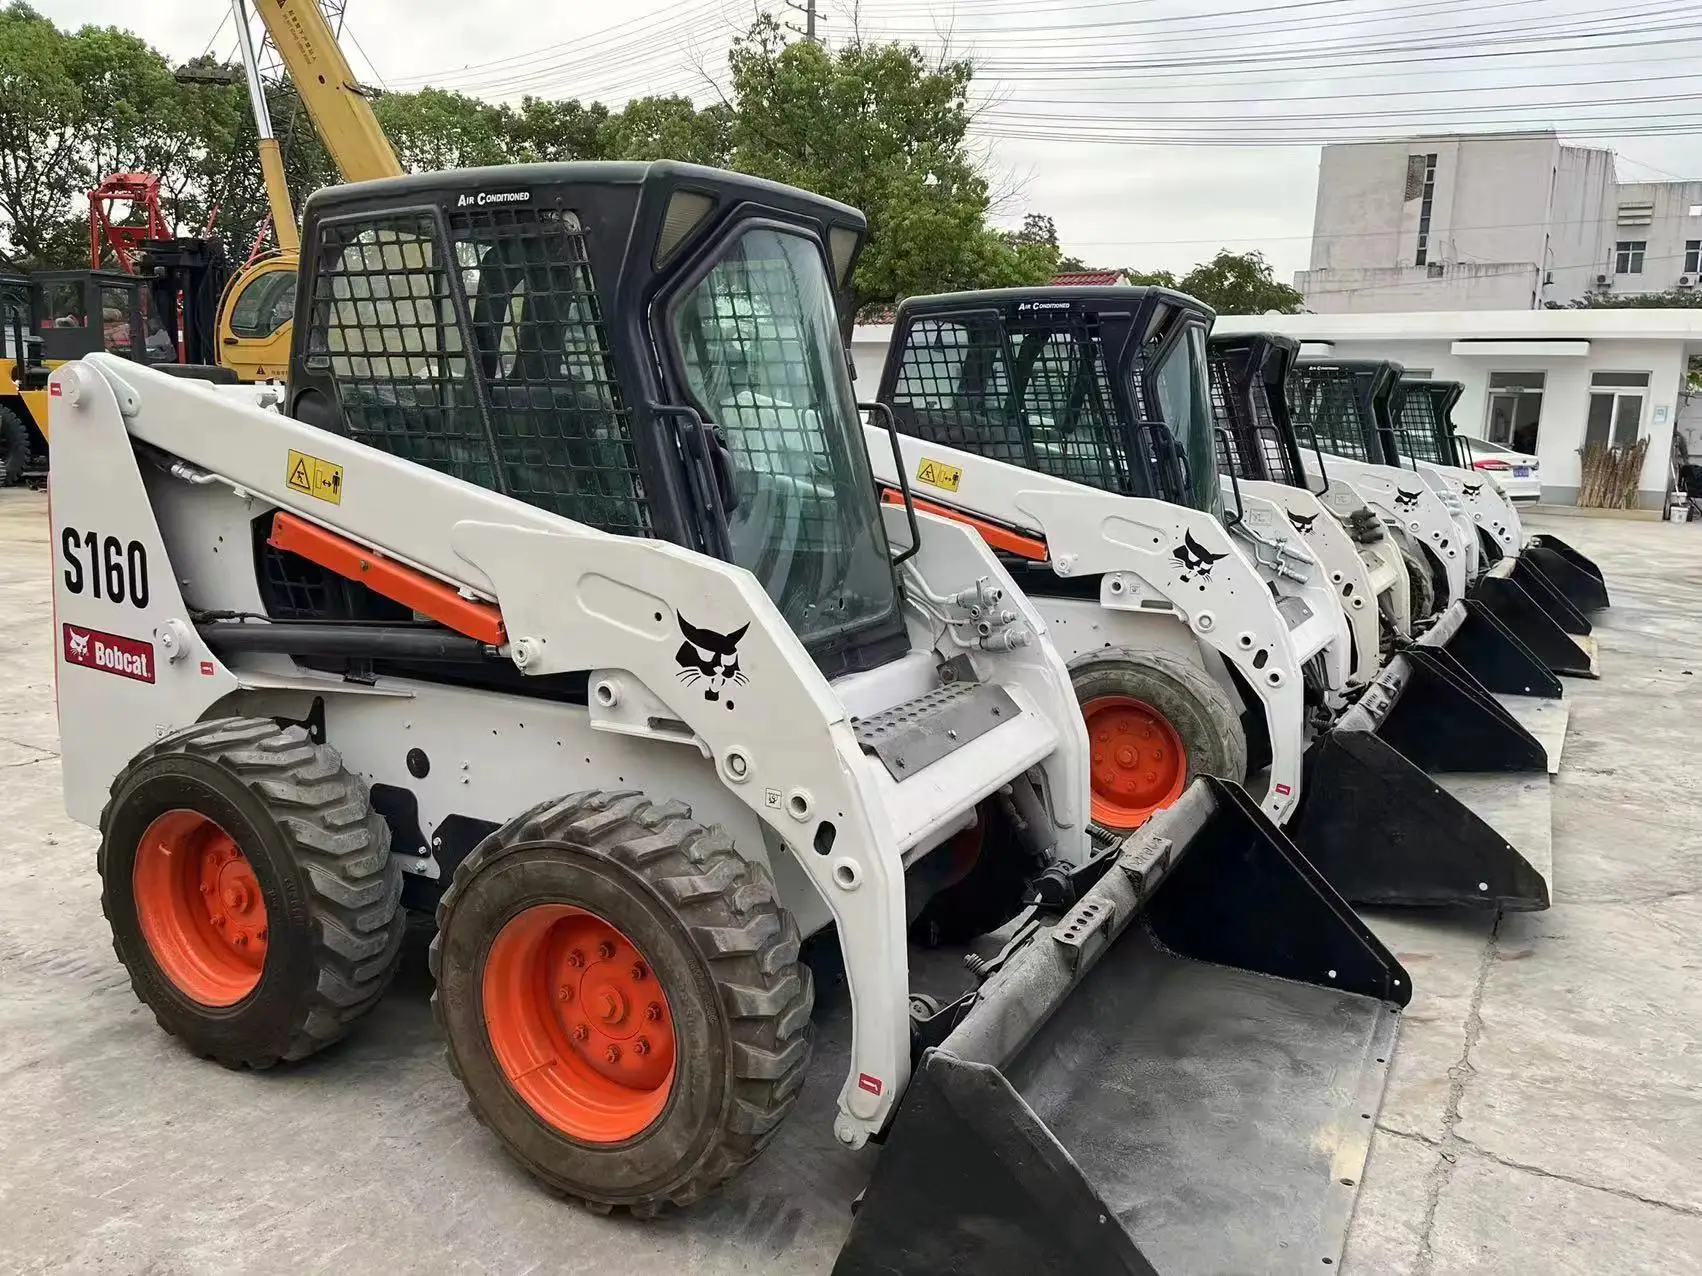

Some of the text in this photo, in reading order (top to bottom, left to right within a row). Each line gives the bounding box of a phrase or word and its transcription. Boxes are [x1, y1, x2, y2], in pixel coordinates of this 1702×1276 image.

[457, 192, 530, 207] AIR CONDITIONED
[62, 526, 149, 609] S160
[94, 641, 149, 678] Bobcat
